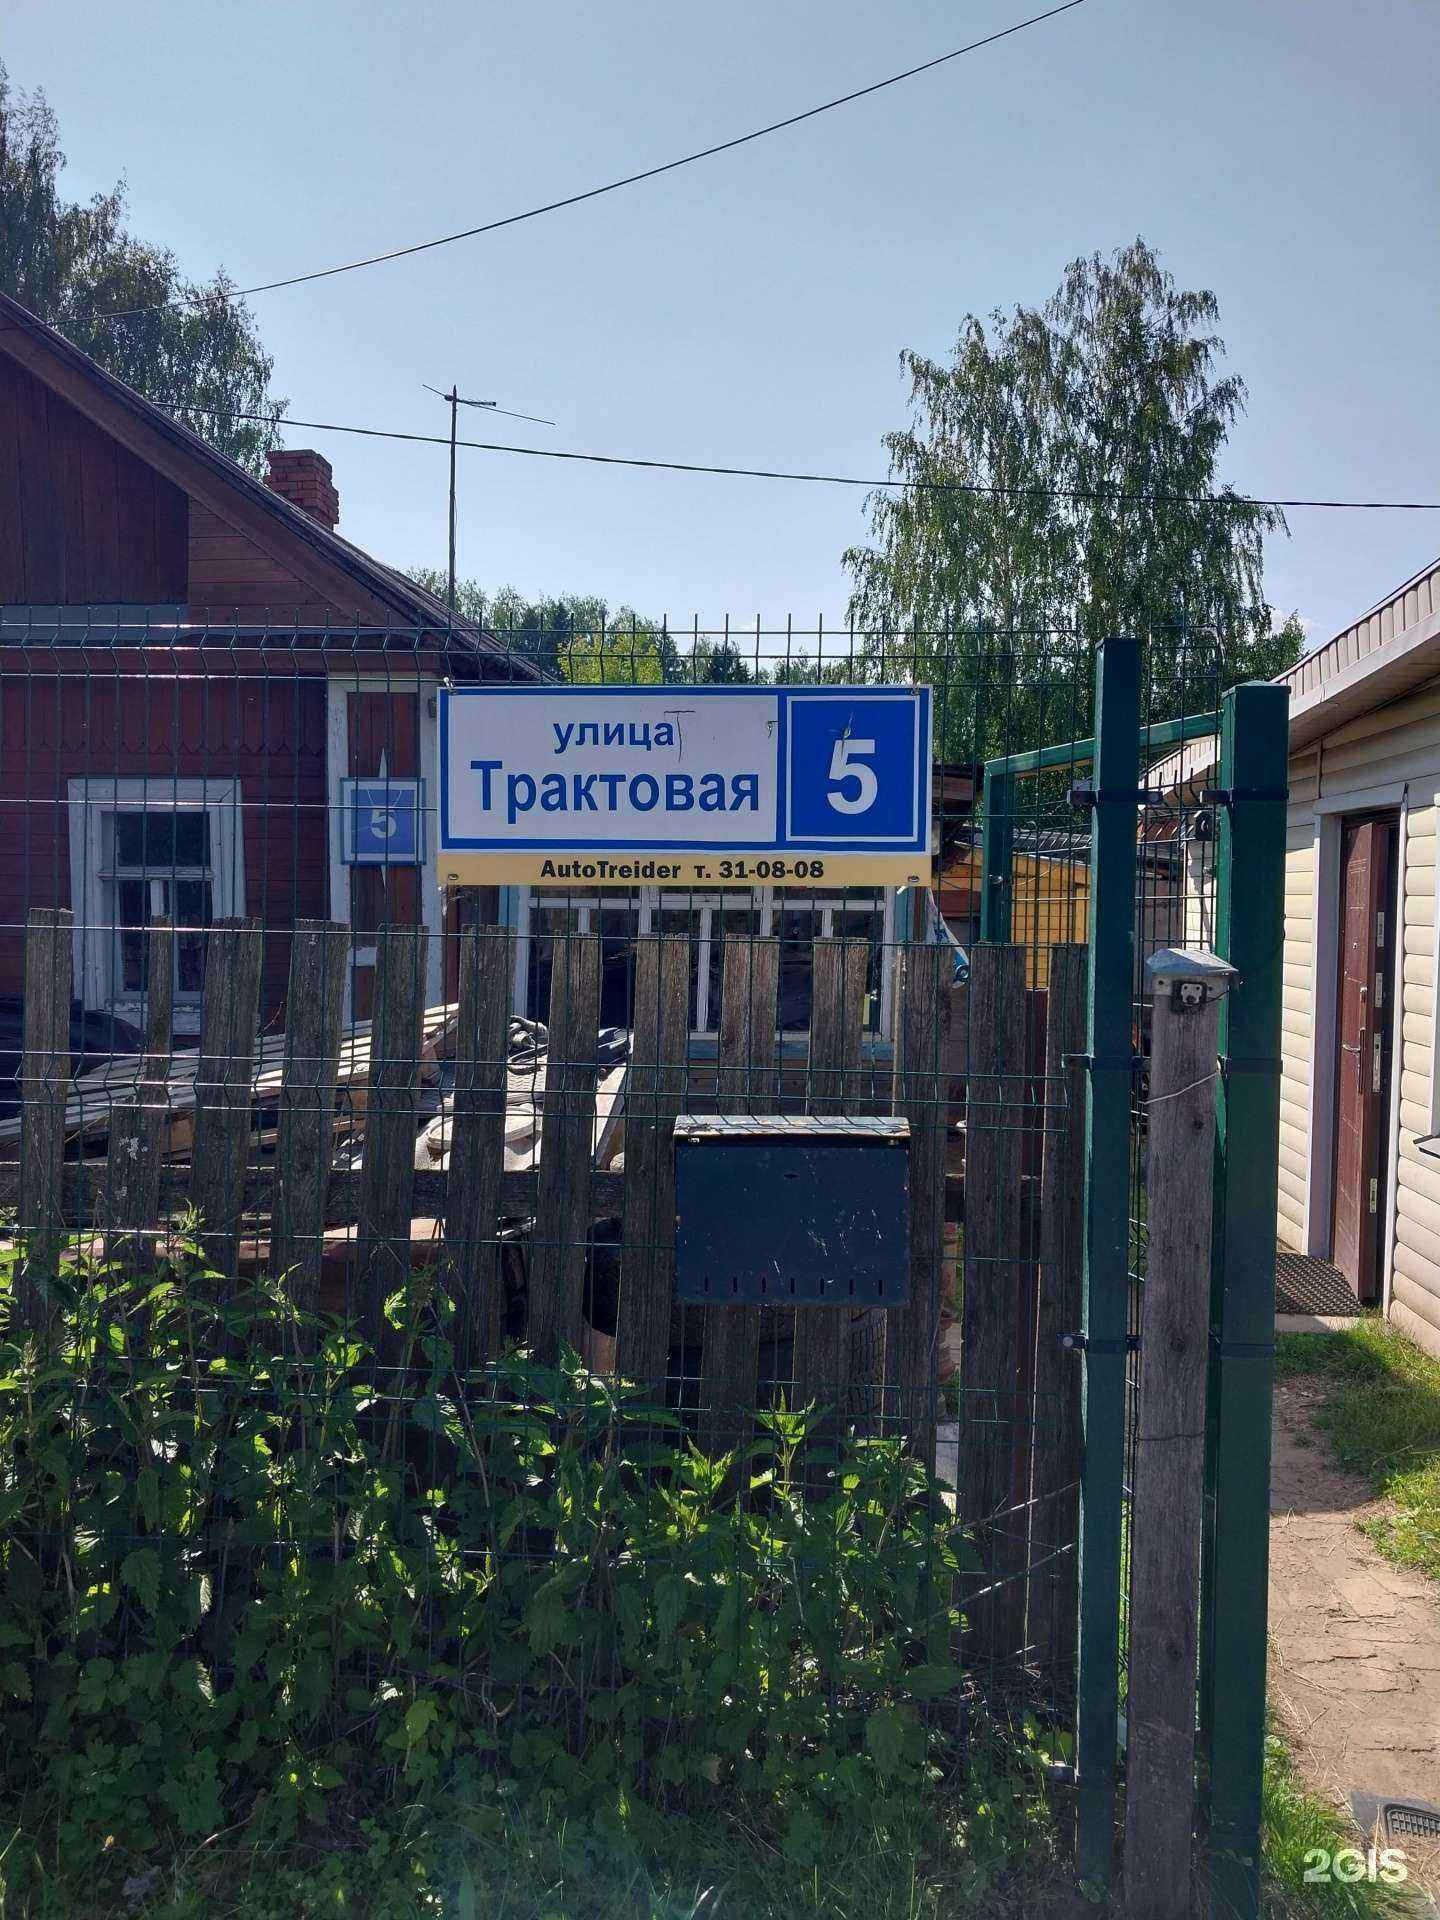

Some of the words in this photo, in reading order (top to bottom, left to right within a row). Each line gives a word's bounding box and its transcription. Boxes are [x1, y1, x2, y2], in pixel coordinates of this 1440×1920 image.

[553, 721, 674, 754] улица
[469, 760, 760, 825] Трактовая
[826, 738, 878, 816] 5
[371, 806, 397, 839] 5
[540, 859, 682, 880] AutoTreider
[718, 861, 825, 880] 31-08-08
